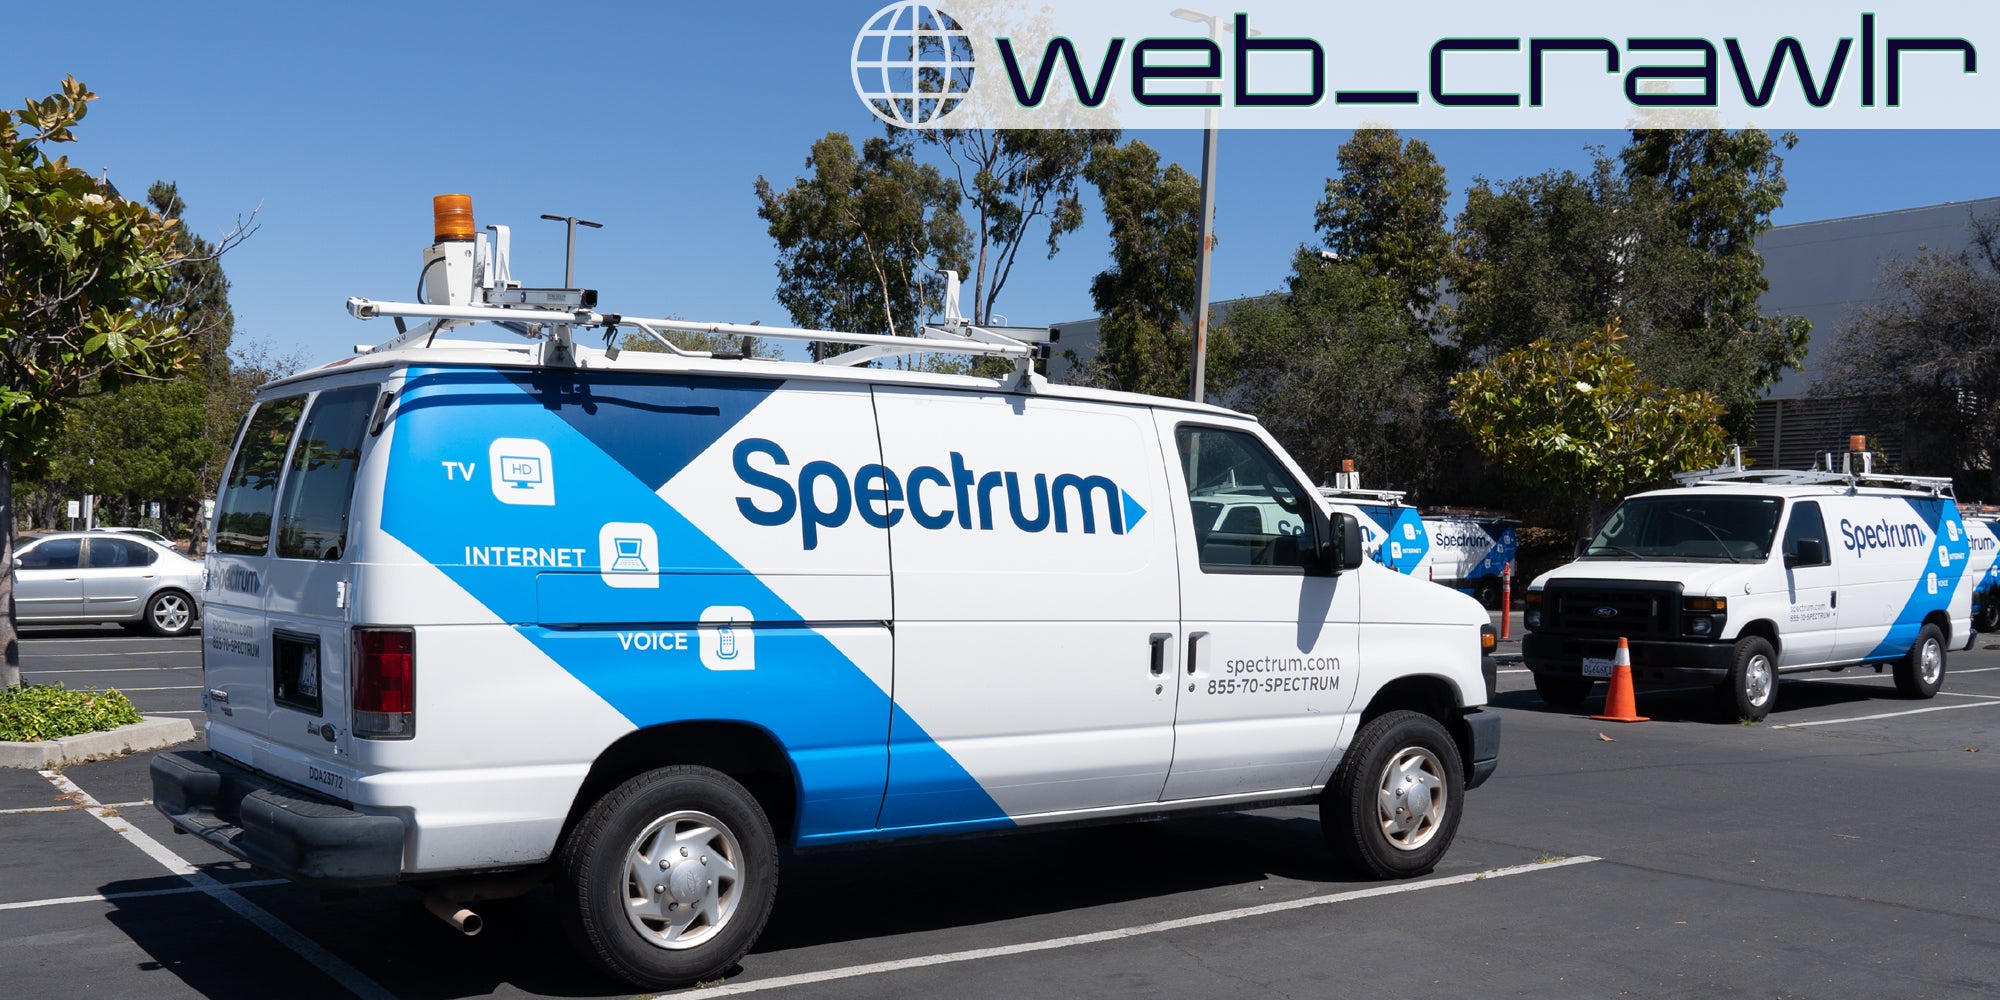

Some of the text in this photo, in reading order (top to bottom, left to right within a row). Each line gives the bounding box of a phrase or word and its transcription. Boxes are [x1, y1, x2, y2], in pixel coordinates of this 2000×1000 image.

[442, 461, 476, 482] TV
[512, 463, 532, 475] HD
[732, 437, 1124, 551] Spectrum
[1436, 533, 1487, 549] Spectrum
[1840, 518, 1923, 558] Spectrum
[465, 546, 587, 568] INTERNET
[617, 632, 688, 651] VOICE
[1226, 655, 1341, 677] spectrum.com
[1207, 675, 1341, 695] 855-70-SPECTRUM
[309, 766, 343, 789] DDA23772
